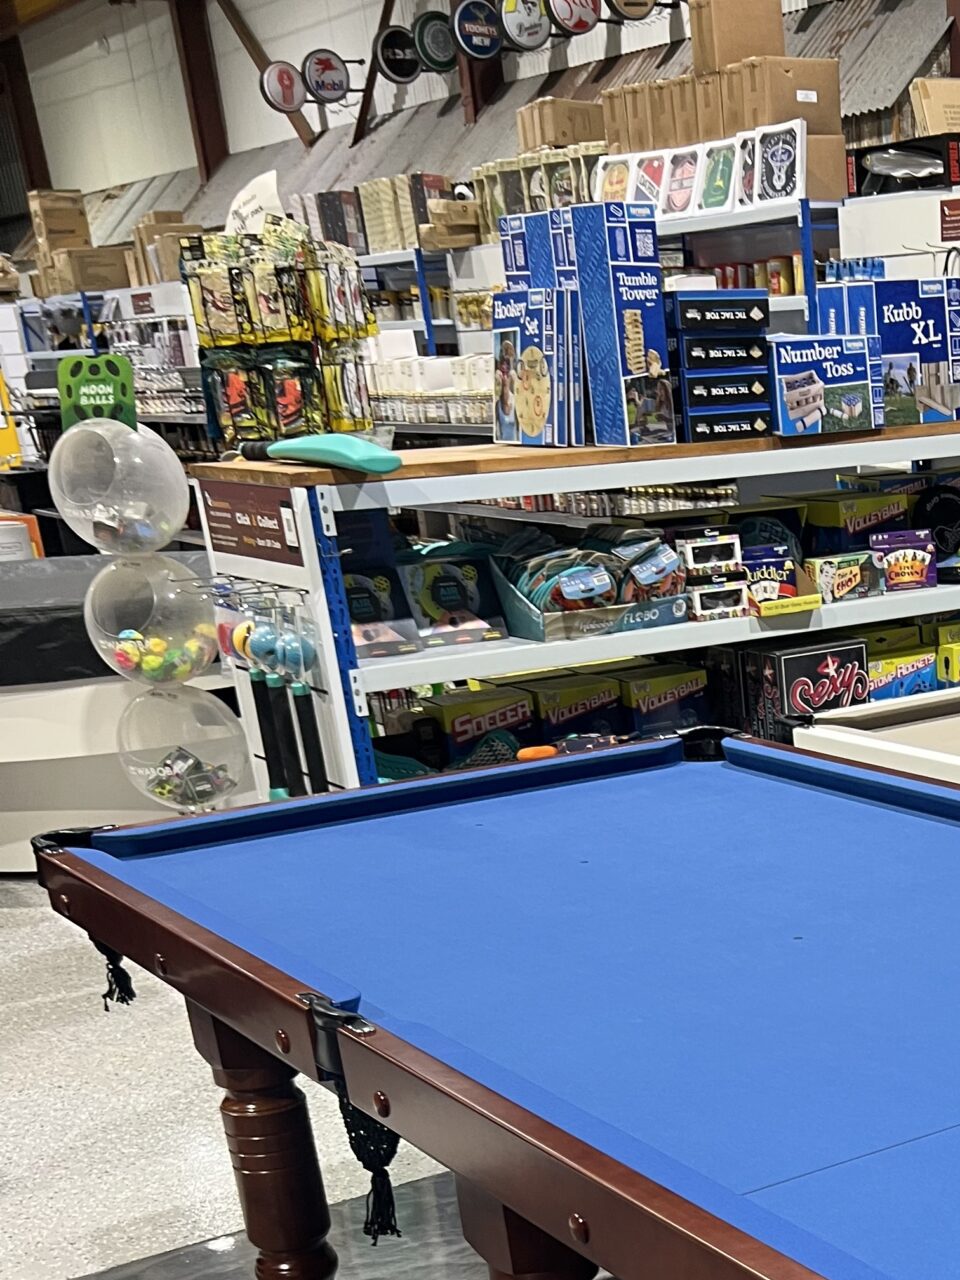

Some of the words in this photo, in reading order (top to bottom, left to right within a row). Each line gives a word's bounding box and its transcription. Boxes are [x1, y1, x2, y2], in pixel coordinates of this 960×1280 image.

[465, 23, 497, 36] TOOHEYS
[472, 36, 491, 48] NEW
[315, 79, 344, 91] Mobil
[616, 272, 658, 286] Tumble
[619, 288, 660, 301] Tower
[494, 300, 527, 324] Hookey
[883, 301, 922, 323] Kubb
[525, 316, 539, 335] Set
[911, 320, 942, 345] XL
[779, 343, 841, 364] Number
[822, 361, 854, 378] Toss
[79, 382, 114, 395] MOON
[80, 395, 115, 405] BALLS
[845, 501, 904, 534] VOLLEYBALL
[836, 572, 858, 592] SHOT
[868, 673, 896, 691] STOMP
[896, 653, 935, 677] ROCKETS
[638, 678, 706, 713] VOLLEYBALL
[548, 688, 619, 725] VOLLEYBALL
[453, 699, 531, 743] SOCCER
